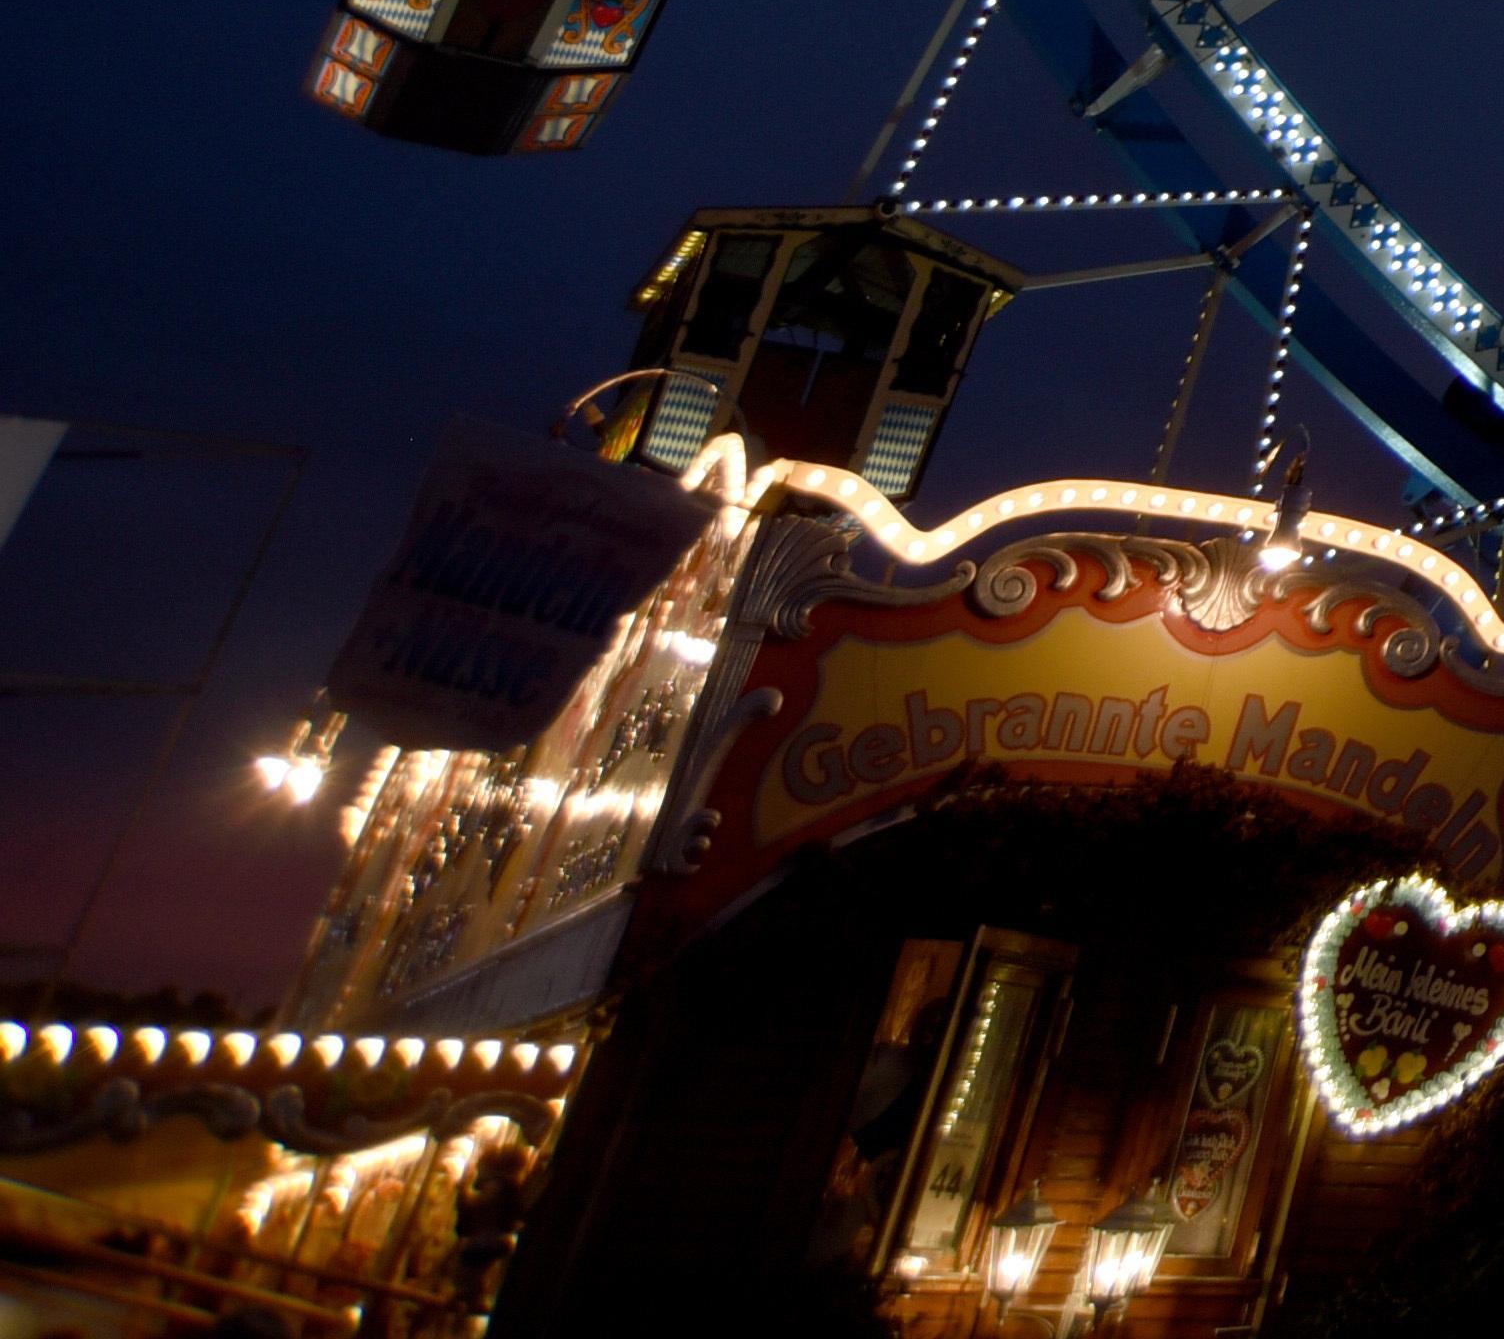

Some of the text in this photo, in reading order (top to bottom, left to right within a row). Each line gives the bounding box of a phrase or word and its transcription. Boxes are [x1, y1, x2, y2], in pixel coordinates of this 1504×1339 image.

[782, 685, 1500, 879] Gebrannte Mandeln
[1340, 945, 1490, 1016] Mein kleines
[929, 1163, 965, 1200] 44
